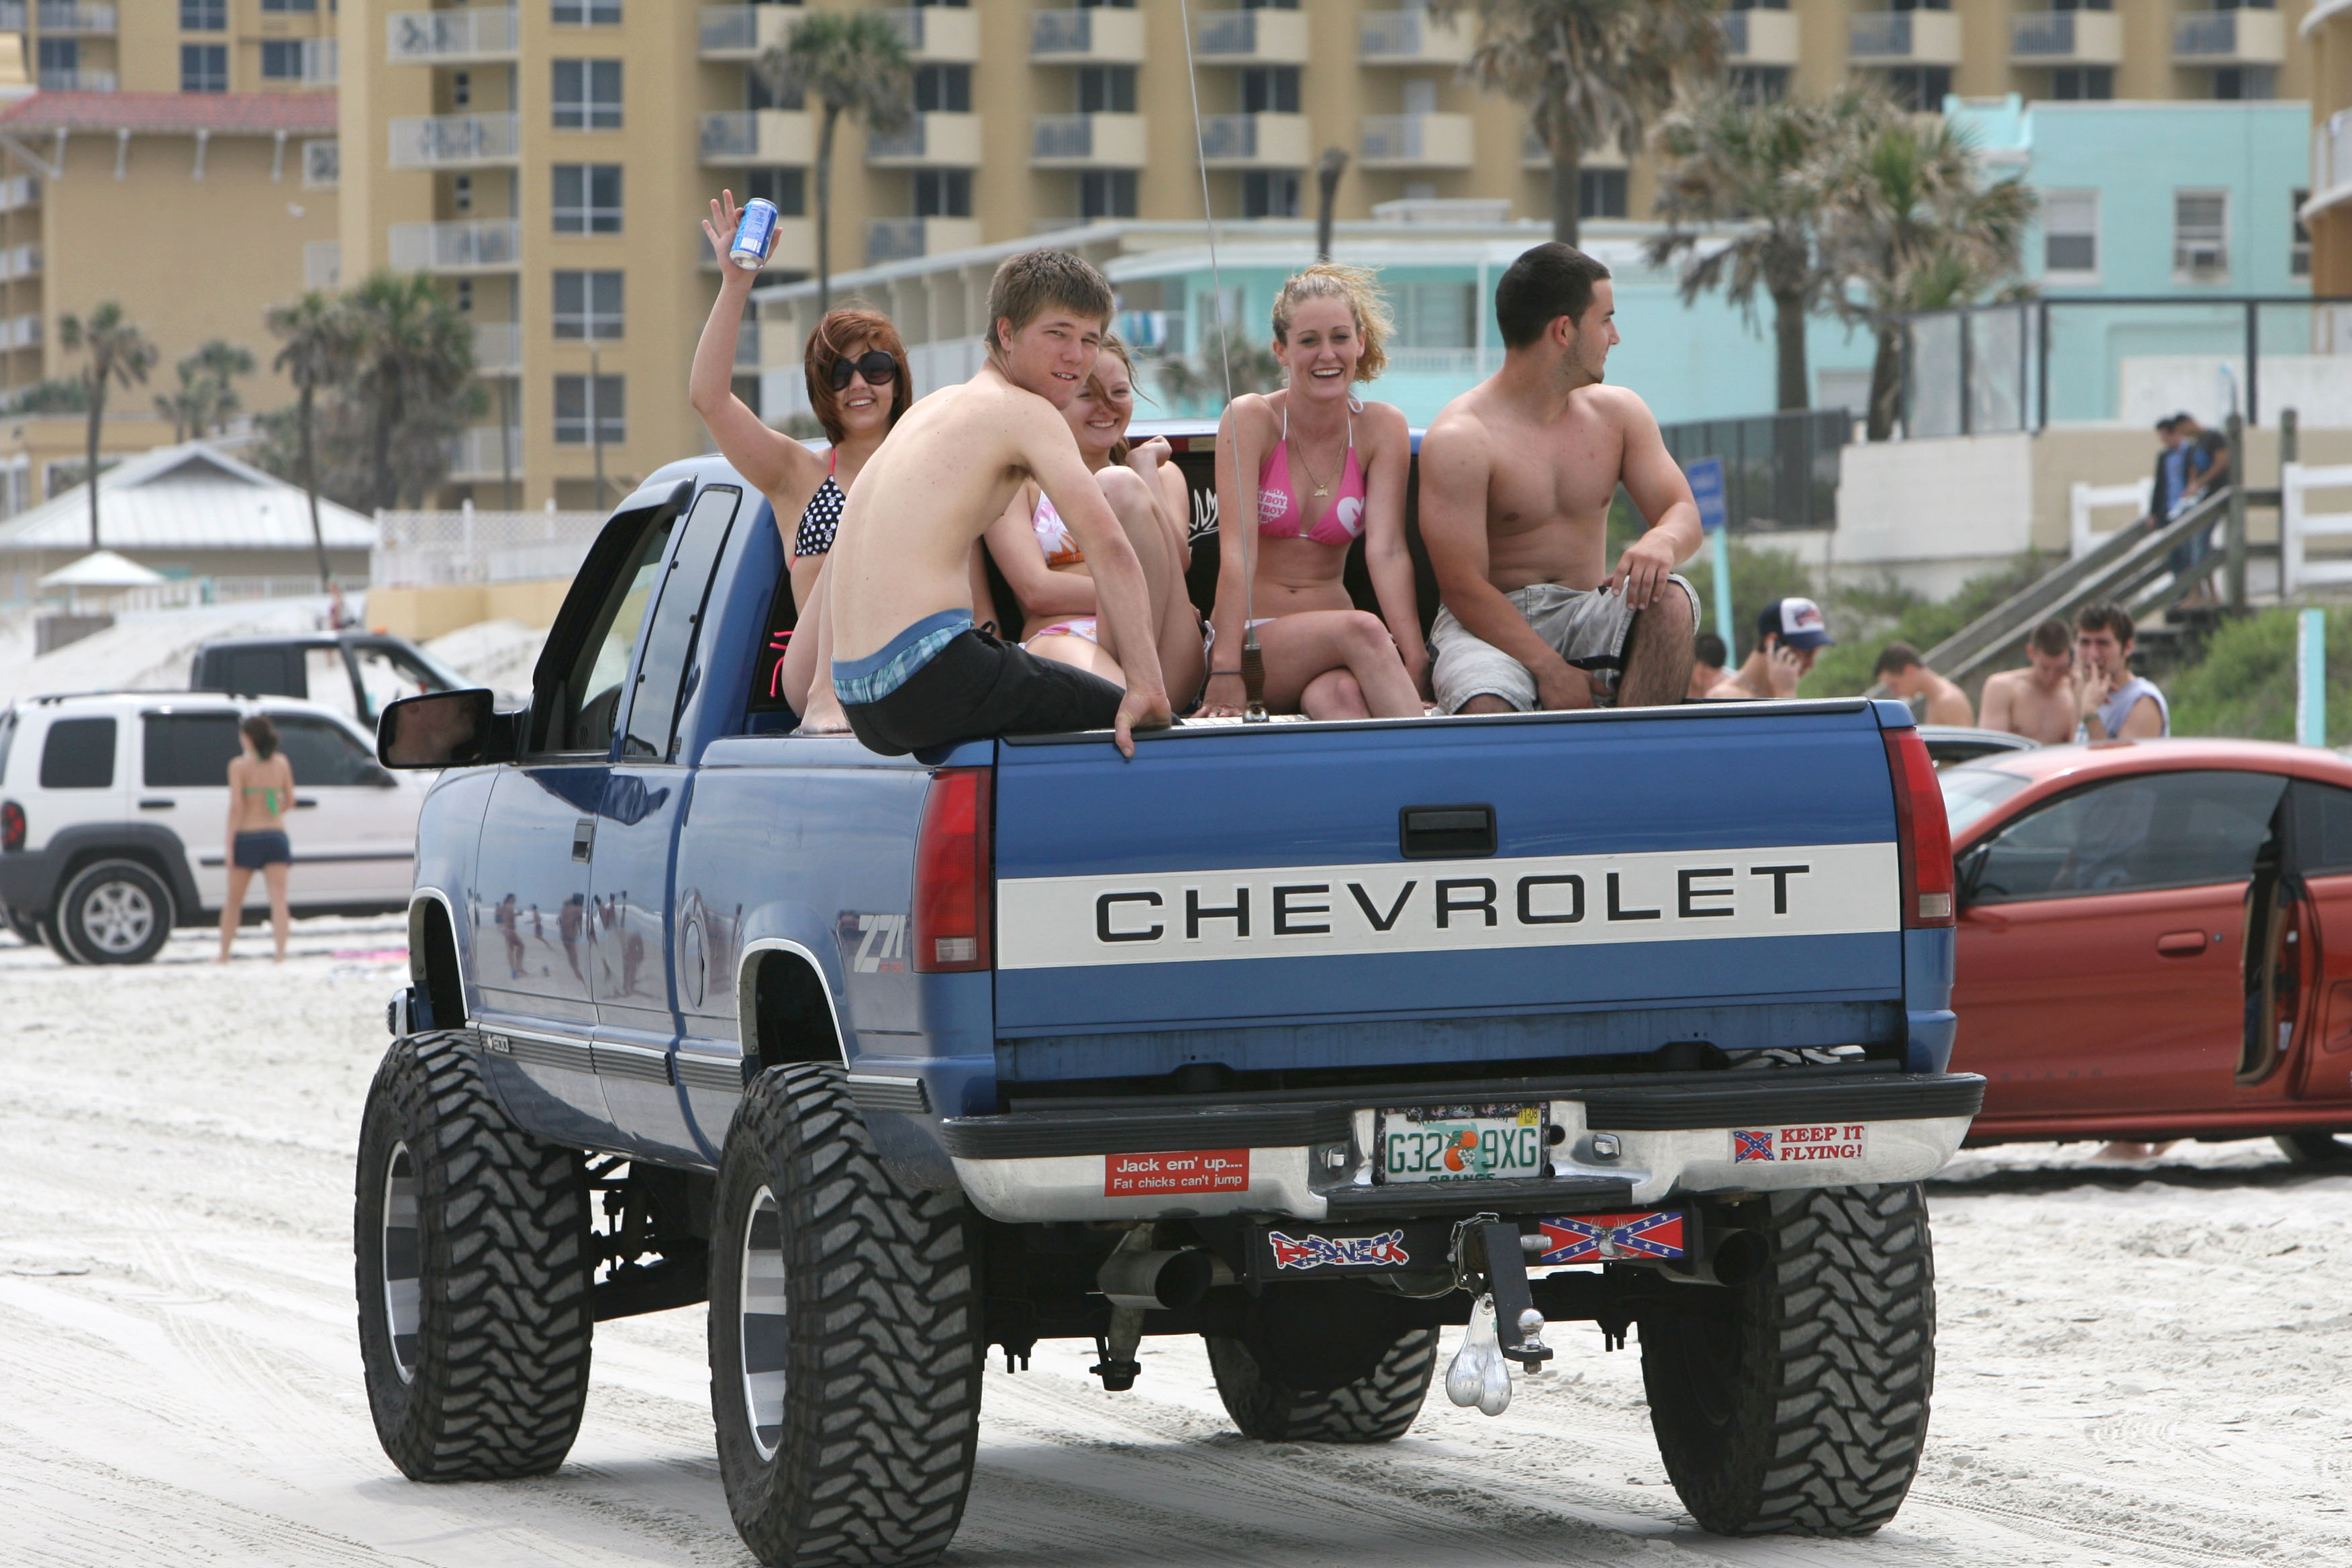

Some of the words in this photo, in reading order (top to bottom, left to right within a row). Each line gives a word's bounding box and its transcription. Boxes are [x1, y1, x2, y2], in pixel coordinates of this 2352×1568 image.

[1095, 864, 1810, 942] CHEVROLET
[853, 914, 907, 973] Z71
[1780, 1127, 1837, 1142] KEEP
[1843, 1125, 1865, 1140] IT
[1116, 1158, 1160, 1173] Jack
[1166, 1156, 1198, 1171] em'
[1387, 1132, 1442, 1173] G32
[1481, 1128, 1536, 1169] 9XG
[1780, 1144, 1862, 1161] FLYING!
[1113, 1178, 1133, 1189] Fat
[1138, 1176, 1175, 1188] chicks
[1181, 1174, 1209, 1186] can't
[1214, 1174, 1242, 1187] jump
[1269, 1229, 1410, 1269] REDNECK
